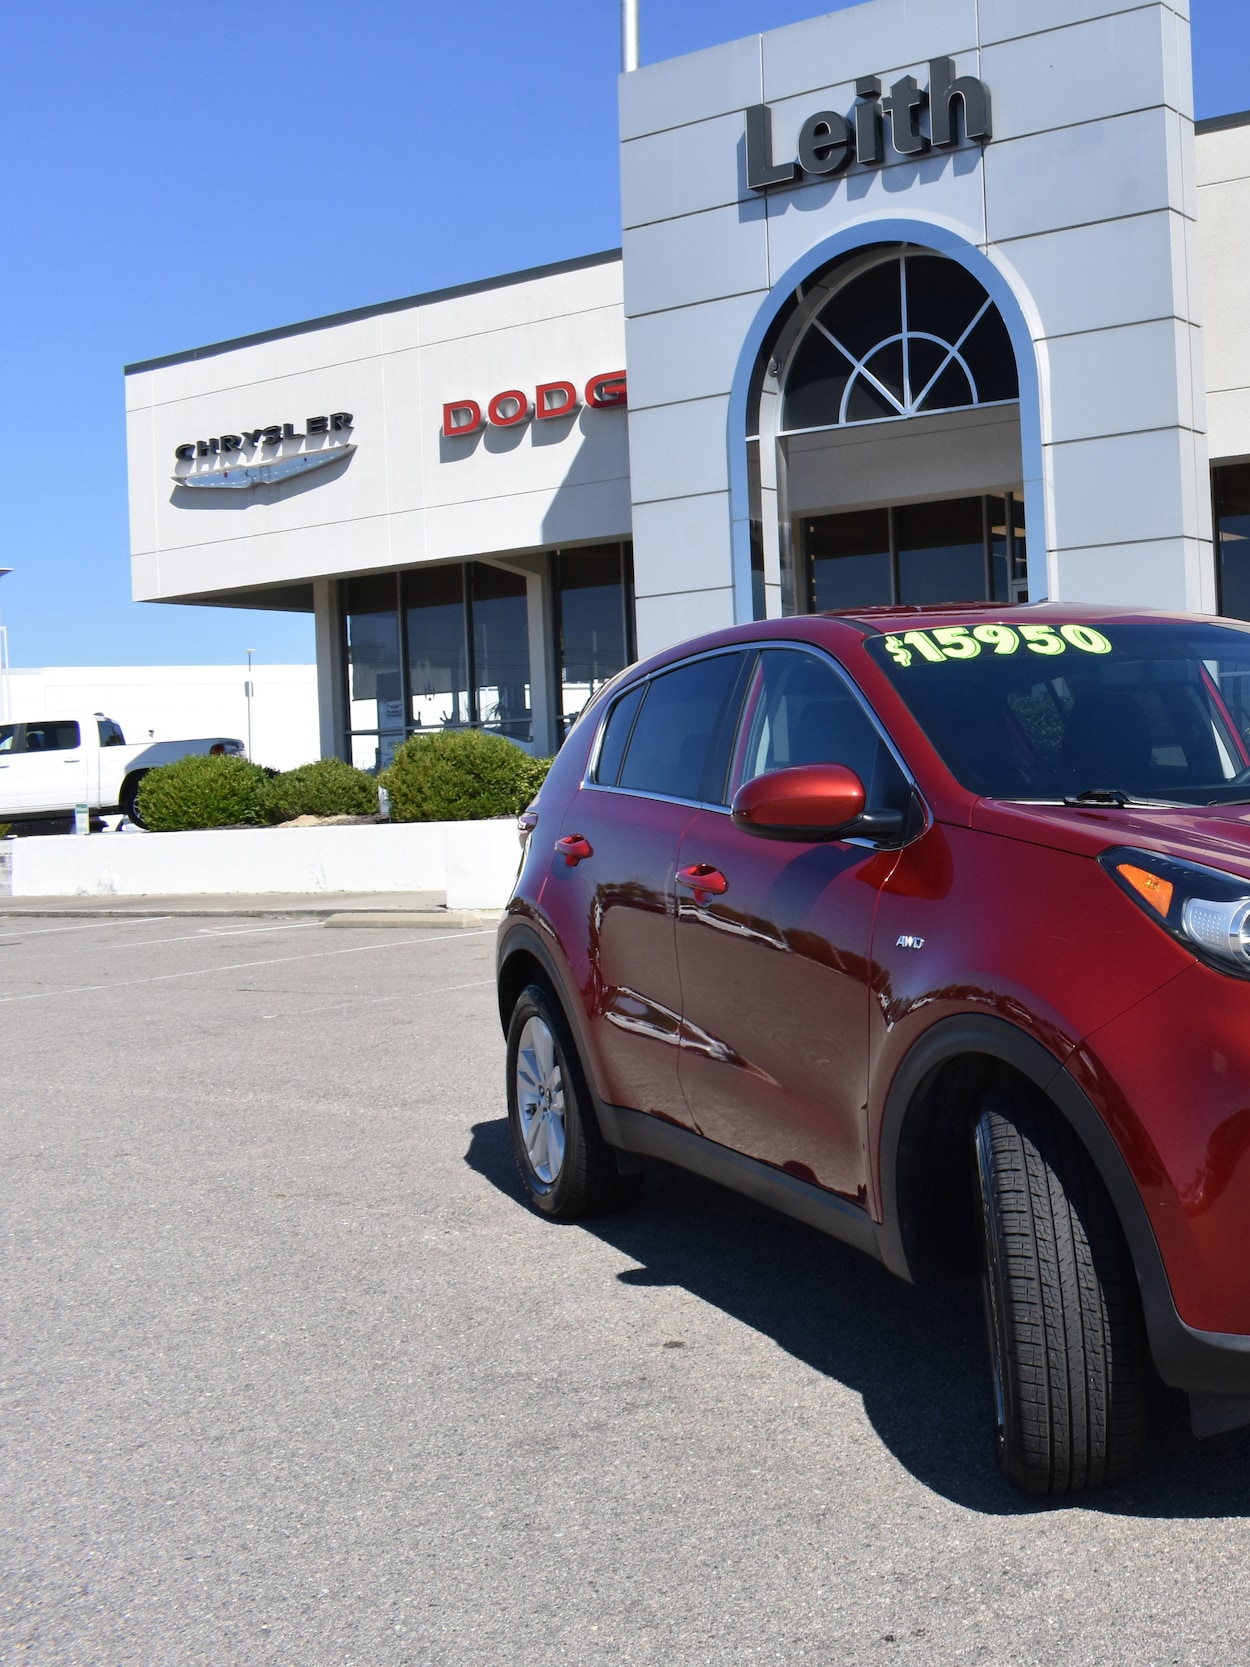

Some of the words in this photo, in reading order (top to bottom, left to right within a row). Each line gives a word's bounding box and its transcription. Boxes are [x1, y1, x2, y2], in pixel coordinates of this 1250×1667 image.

[745, 55, 993, 191] Leith
[175, 412, 355, 461] CHRYSLER
[885, 624, 1112, 667] $15950
